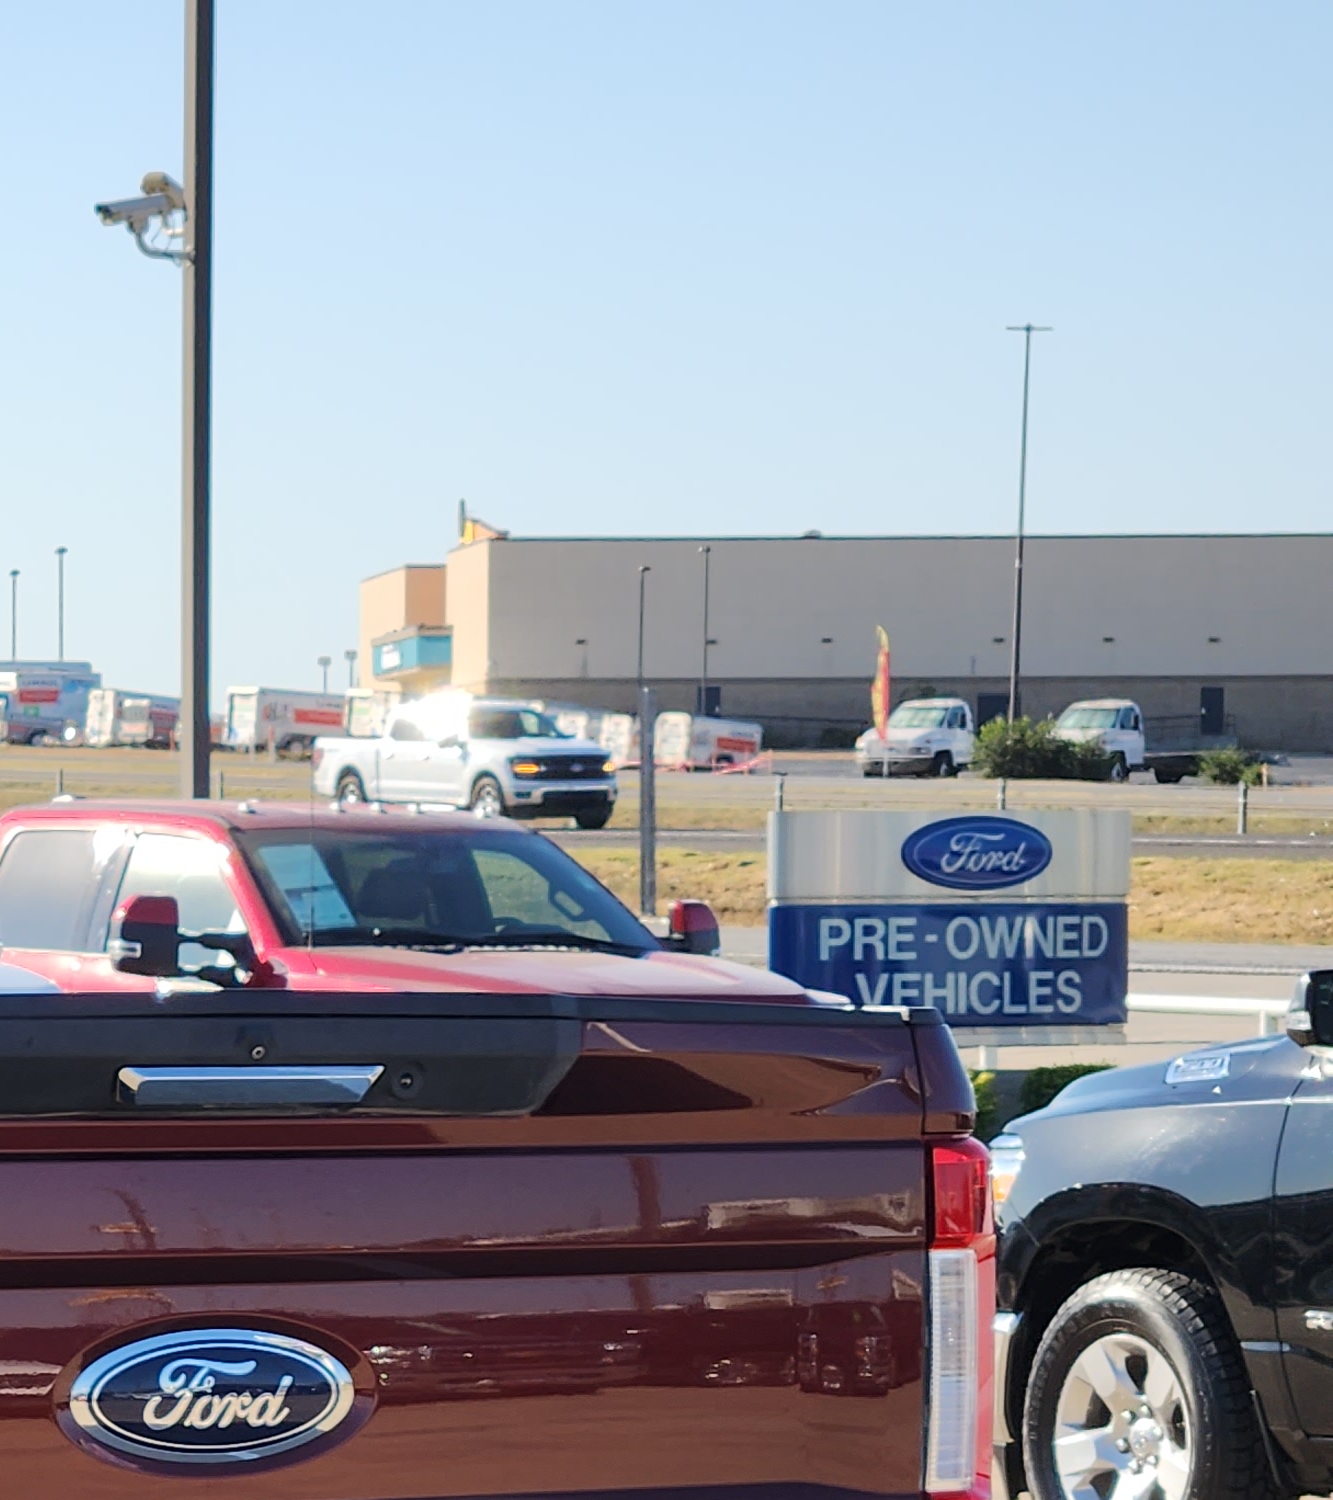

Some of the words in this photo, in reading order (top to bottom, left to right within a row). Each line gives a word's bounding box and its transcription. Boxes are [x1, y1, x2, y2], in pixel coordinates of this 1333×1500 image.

[939, 832, 1026, 874] Ford
[855, 970, 1083, 1015] VEHICLES
[143, 1357, 295, 1431] Ford
